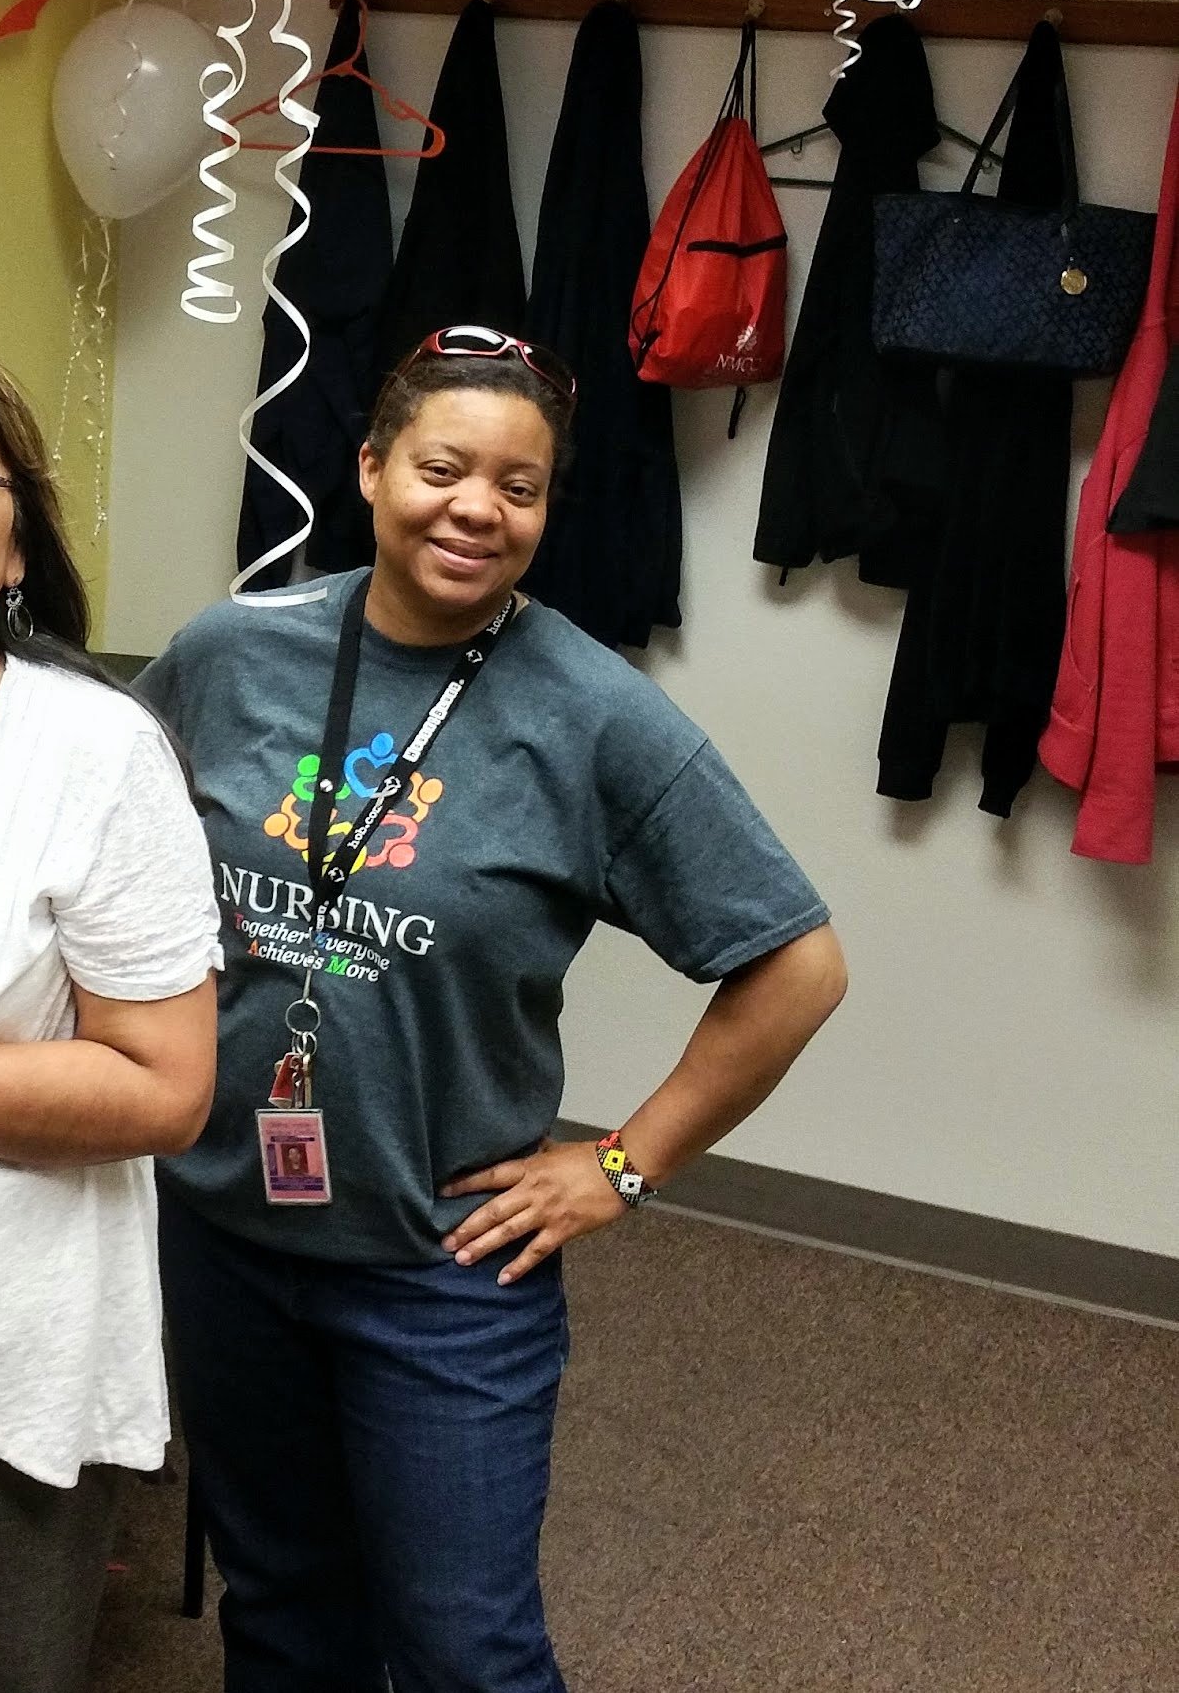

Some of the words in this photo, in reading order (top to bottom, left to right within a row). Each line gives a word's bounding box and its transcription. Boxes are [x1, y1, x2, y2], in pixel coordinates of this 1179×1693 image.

[234, 912, 310, 945] Together
[315, 932, 390, 971] Everyone
[247, 939, 325, 970] Achieves
[325, 955, 379, 982] More
